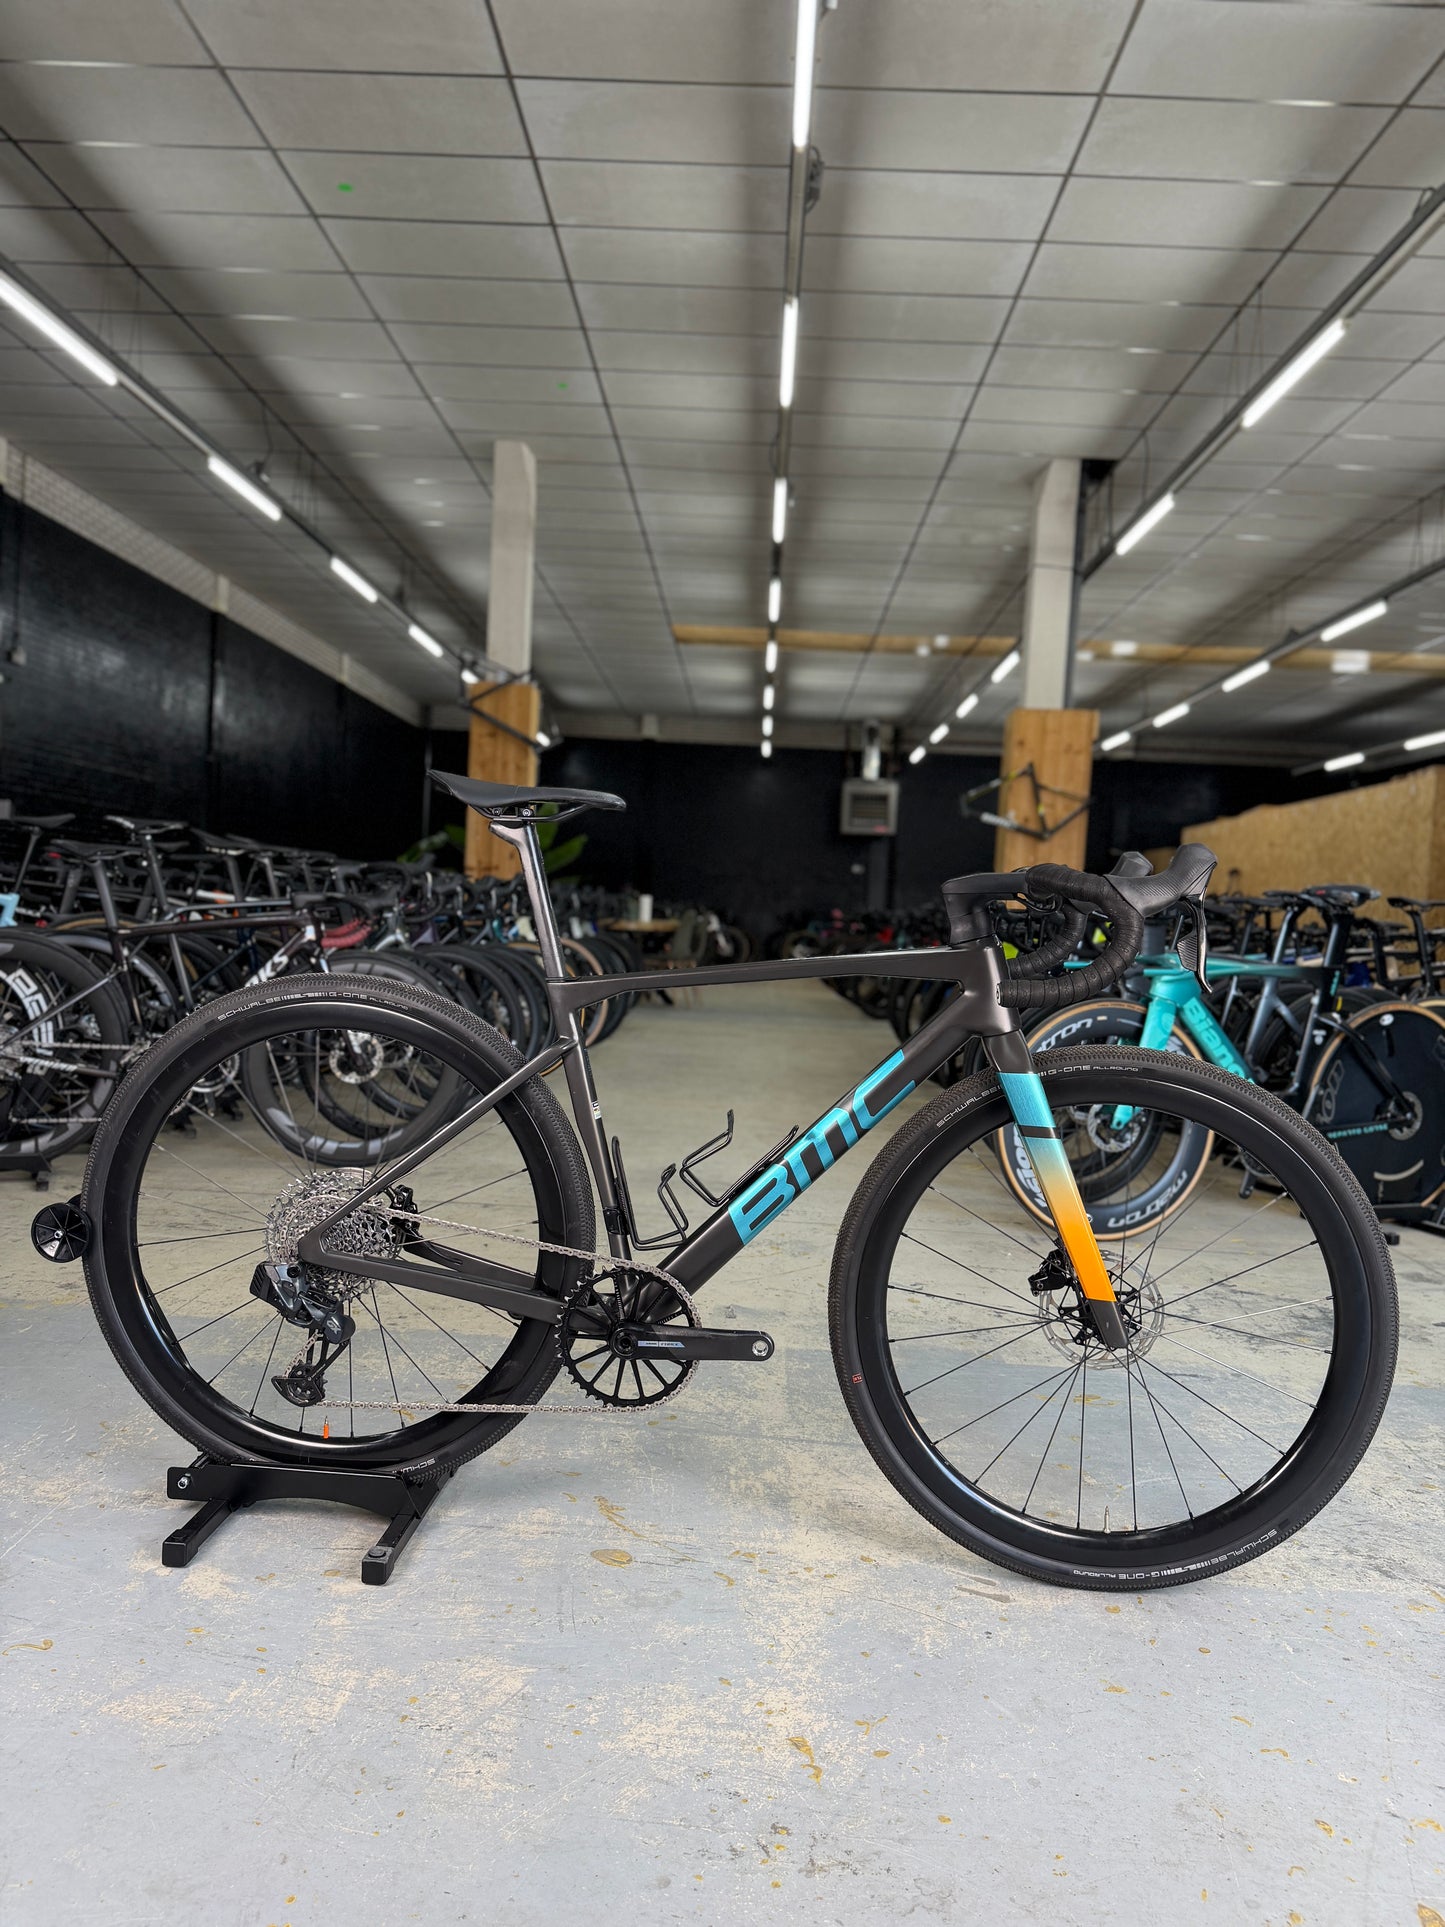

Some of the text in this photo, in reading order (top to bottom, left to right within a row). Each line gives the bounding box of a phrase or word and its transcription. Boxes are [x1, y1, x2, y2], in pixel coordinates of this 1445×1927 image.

[217, 995, 281, 1022] SCHWALBE
[328, 991, 368, 999] G-ONE
[1037, 1017, 1093, 1052] tron
[1182, 996, 1254, 1085] Bianc
[936, 1085, 998, 1129] SCHWALBE
[1048, 1064, 1091, 1076] G-ONE
[728, 1048, 916, 1246] BMC
[401, 1457, 436, 1474] SCHW
[1210, 1528, 1278, 1564] SCHWALBE
[1118, 1571, 1160, 1580] G-ONE
